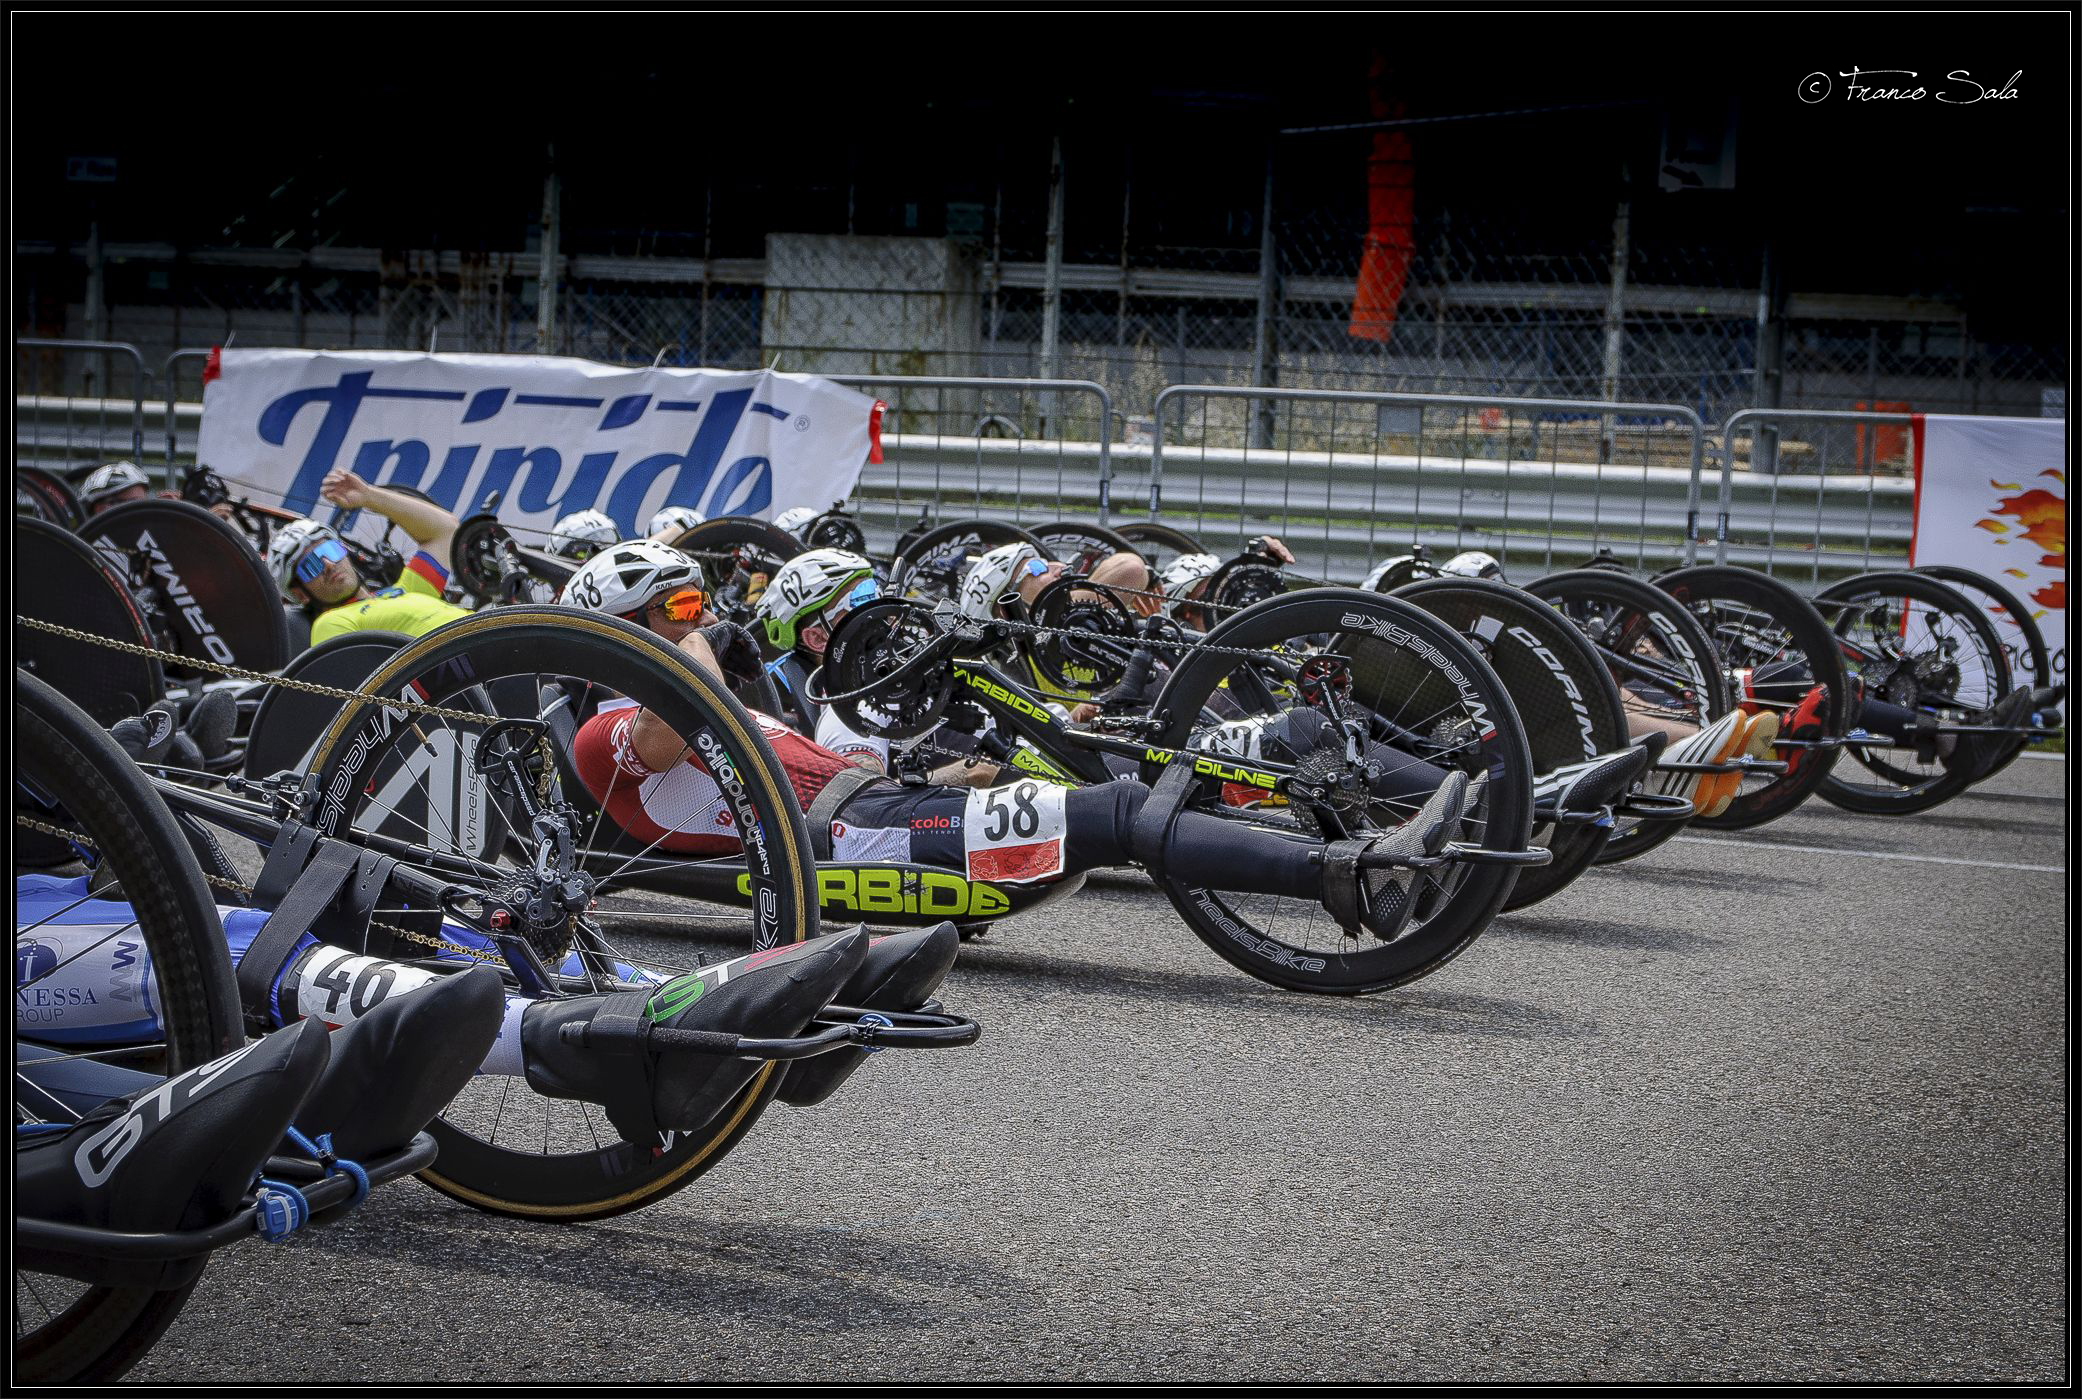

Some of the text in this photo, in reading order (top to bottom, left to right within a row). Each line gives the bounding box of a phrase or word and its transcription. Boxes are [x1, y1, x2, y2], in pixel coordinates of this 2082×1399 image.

[137, 530, 235, 668] ORIMA
[780, 570, 812, 607] 62
[967, 575, 990, 604] 53
[952, 664, 1051, 724] ARBIDE
[1507, 626, 1597, 762] CORIM
[983, 781, 1040, 842] 58
[1189, 887, 1327, 974] heelsBike
[312, 953, 397, 1019] 40
